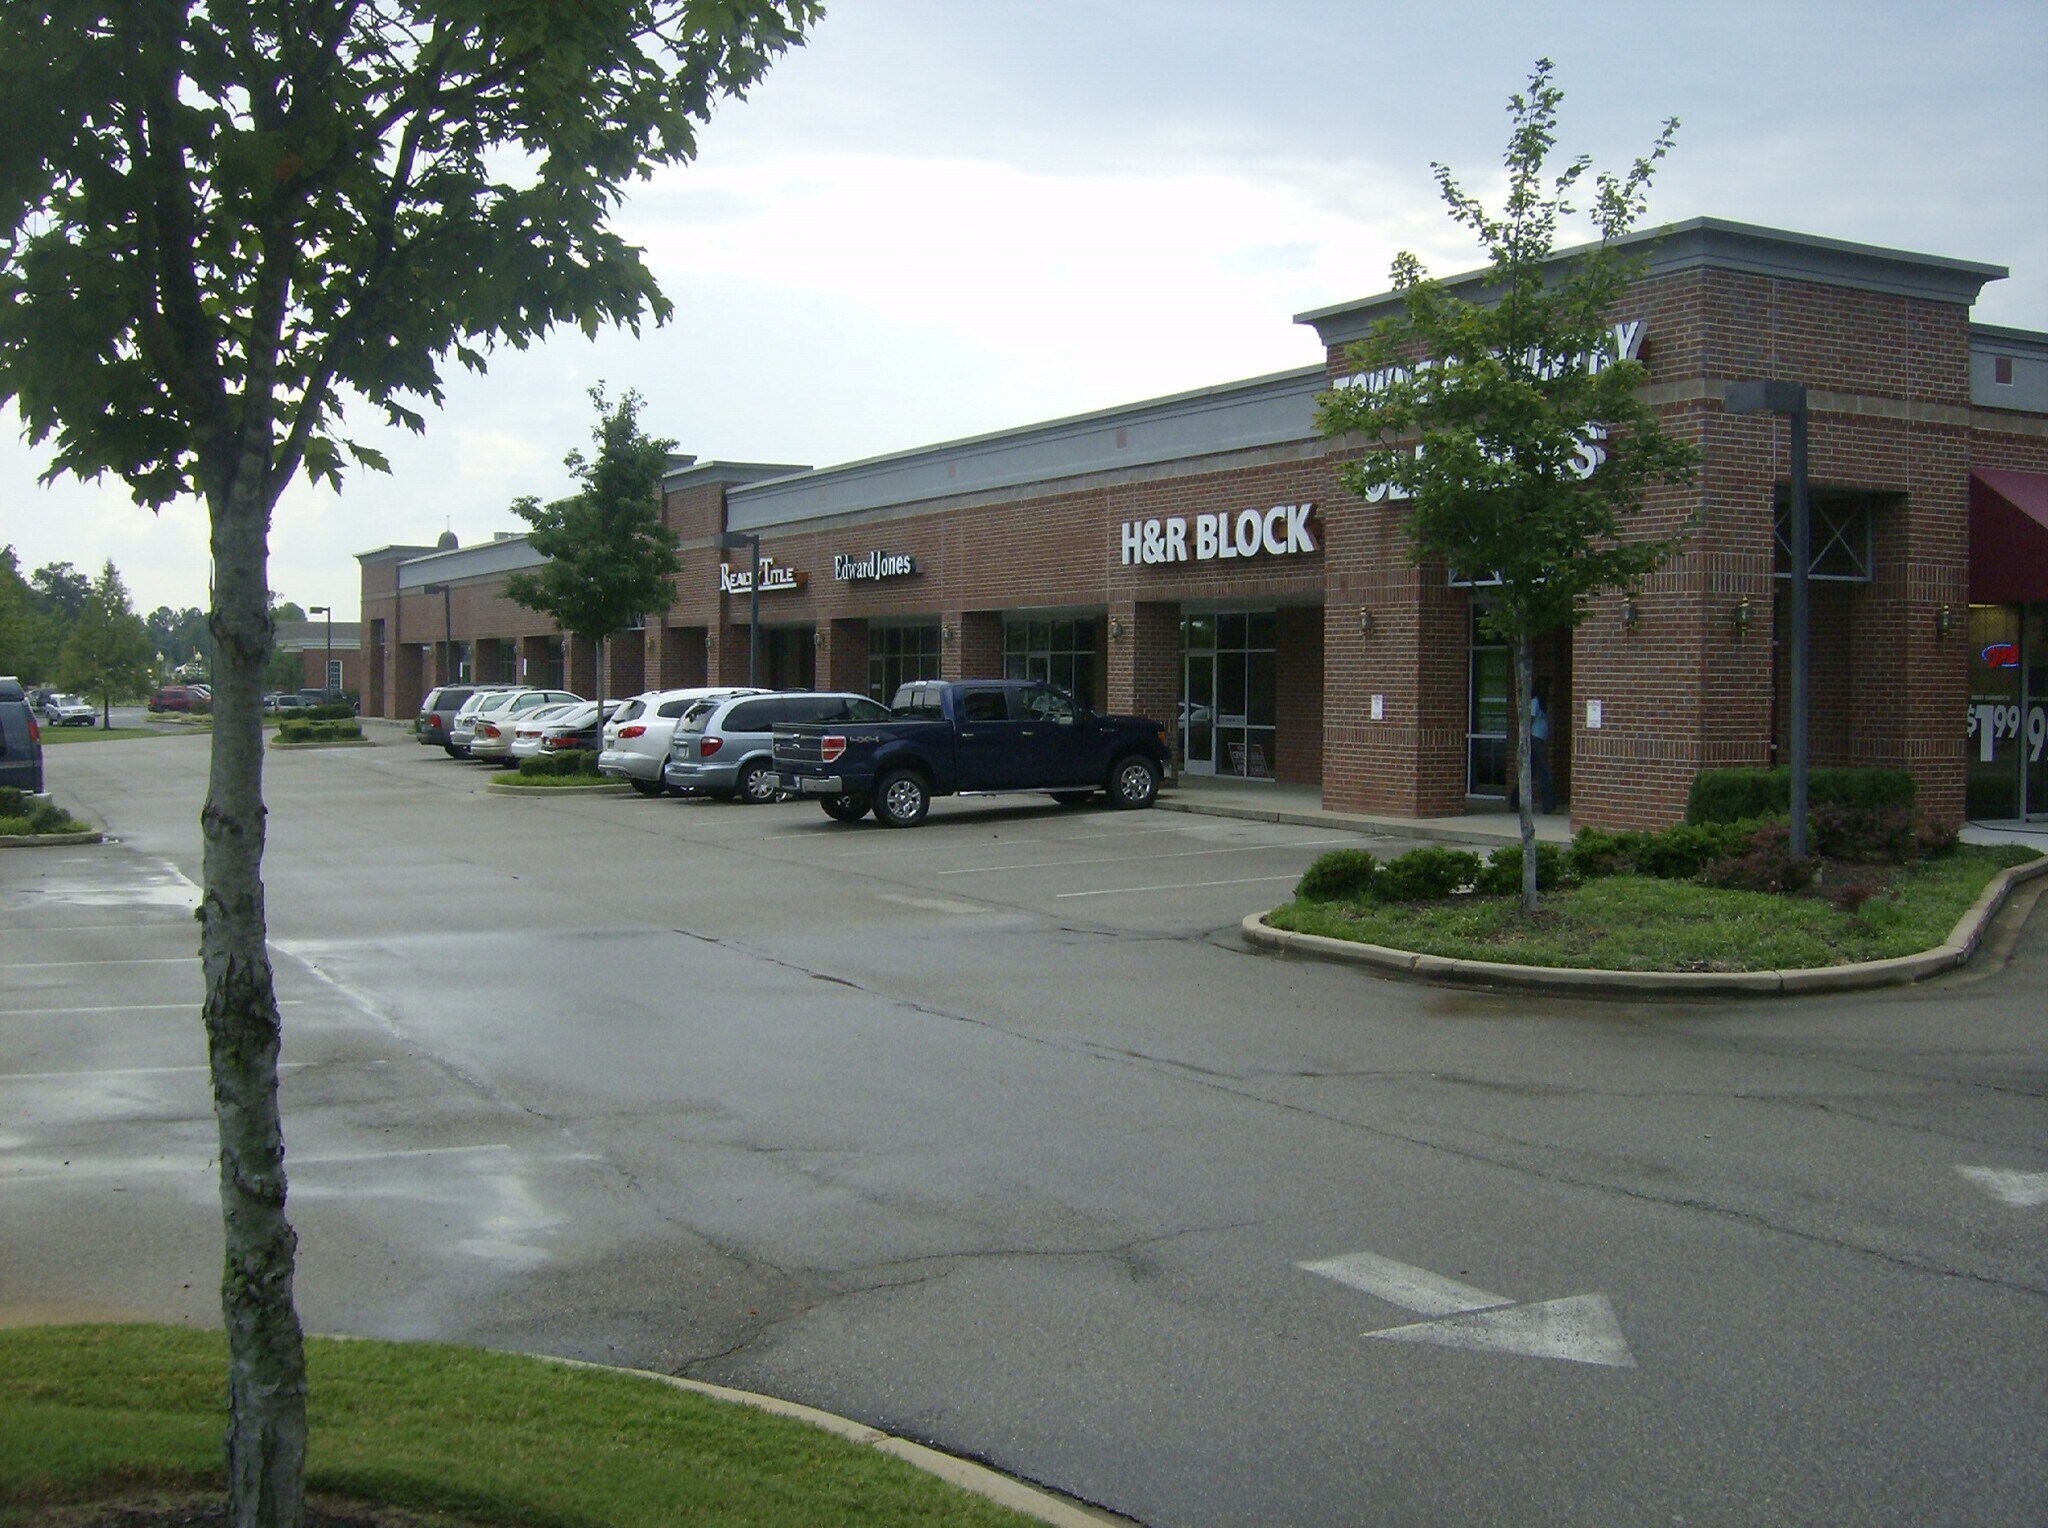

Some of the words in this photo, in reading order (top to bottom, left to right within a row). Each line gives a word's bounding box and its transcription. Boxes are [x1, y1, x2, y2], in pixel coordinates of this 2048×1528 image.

[1121, 517, 1188, 565] H&R
[1196, 503, 1315, 560] BLOCK
[720, 563, 761, 594] REALT
[834, 551, 875, 581] Edward
[875, 550, 911, 581] Jones
